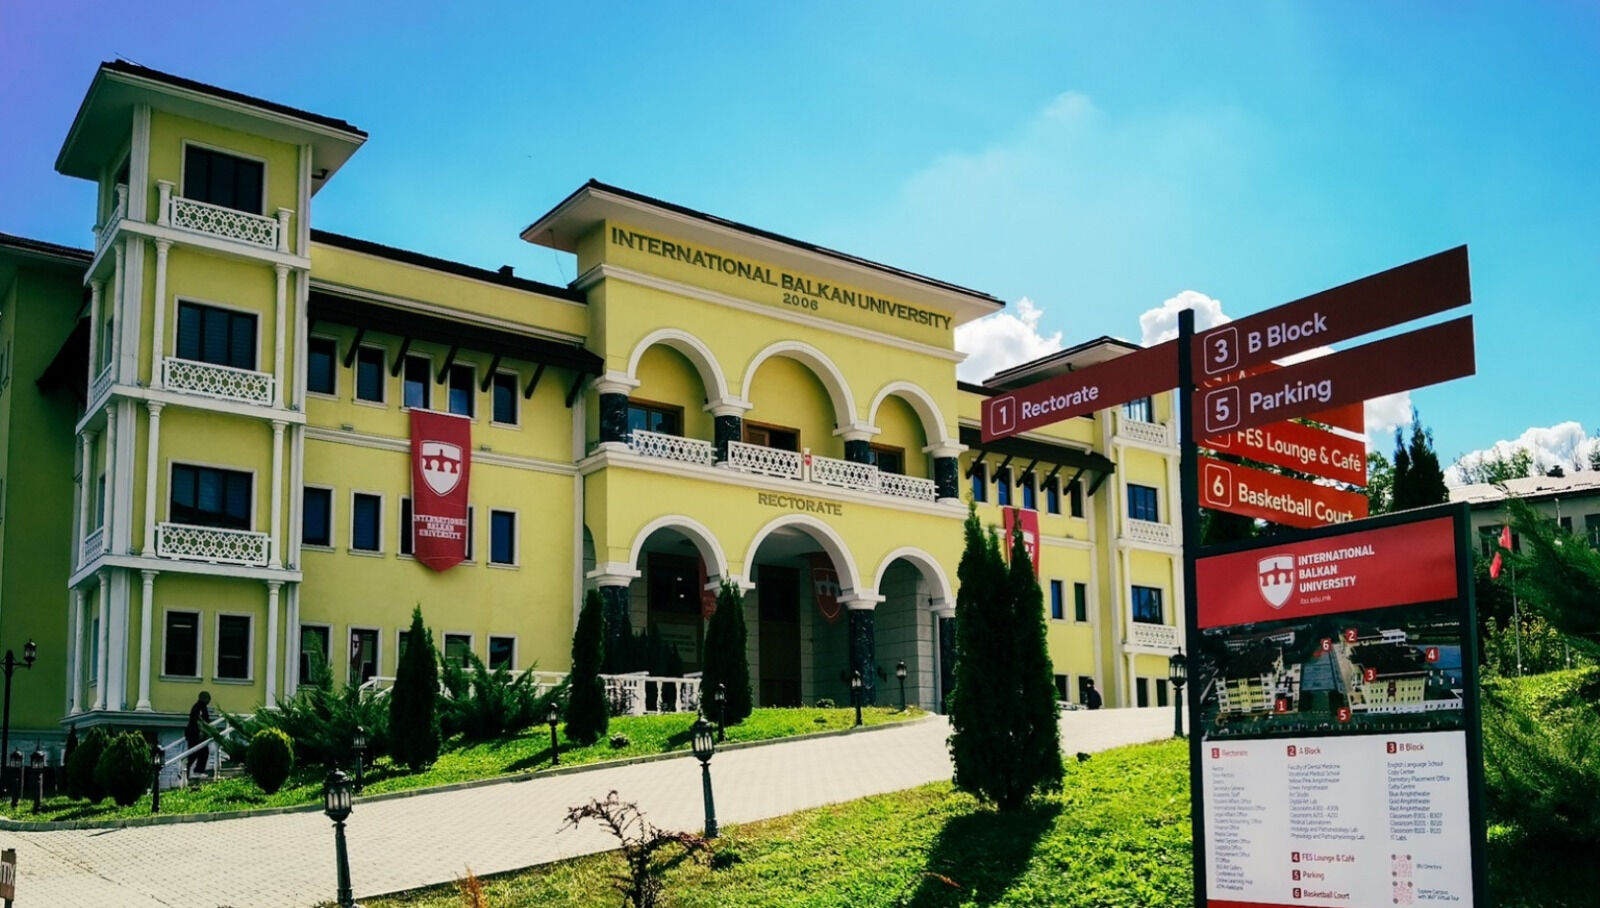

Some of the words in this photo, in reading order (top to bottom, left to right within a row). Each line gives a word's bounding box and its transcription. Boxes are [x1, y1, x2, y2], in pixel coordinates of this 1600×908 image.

[611, 227, 778, 288] INTERNATIONAL
[781, 273, 855, 307] BALKAN
[858, 296, 952, 331] UNIVERSITY
[783, 293, 818, 311] 2006
[1214, 339, 1229, 363] 3
[1248, 332, 1261, 353] B
[1267, 312, 1328, 347] Block
[1000, 406, 1007, 425] 1
[1022, 386, 1099, 420] Rectorate
[1215, 397, 1230, 421] 5
[1250, 379, 1331, 413] Parking
[1237, 428, 1263, 448] FES
[1267, 432, 1316, 464] Lounge
[1319, 447, 1329, 465] &
[1331, 452, 1362, 472] Café
[758, 492, 843, 516] RECTORATE
[1213, 475, 1225, 497] 6
[1238, 482, 1312, 517] Basketball
[1314, 502, 1353, 523] Court
[1298, 544, 1375, 567] INTERNATIONAL
[1299, 565, 1338, 579] BALKAN
[1299, 576, 1357, 593] UNIVERSITY
[1348, 631, 1355, 640] 2
[1322, 640, 1329, 650] 6
[1428, 649, 1436, 659] 4
[1367, 670, 1374, 680] 3
[1278, 701, 1284, 710] 1
[1340, 710, 1347, 720] 5
[1304, 746, 1320, 754] Block
[1399, 743, 1404, 751] B
[1406, 743, 1424, 751] Block
[1302, 853, 1313, 861] FES
[1302, 871, 1325, 880] Parking
[1303, 889, 1333, 898] Basketball
[1333, 891, 1350, 900] Court
